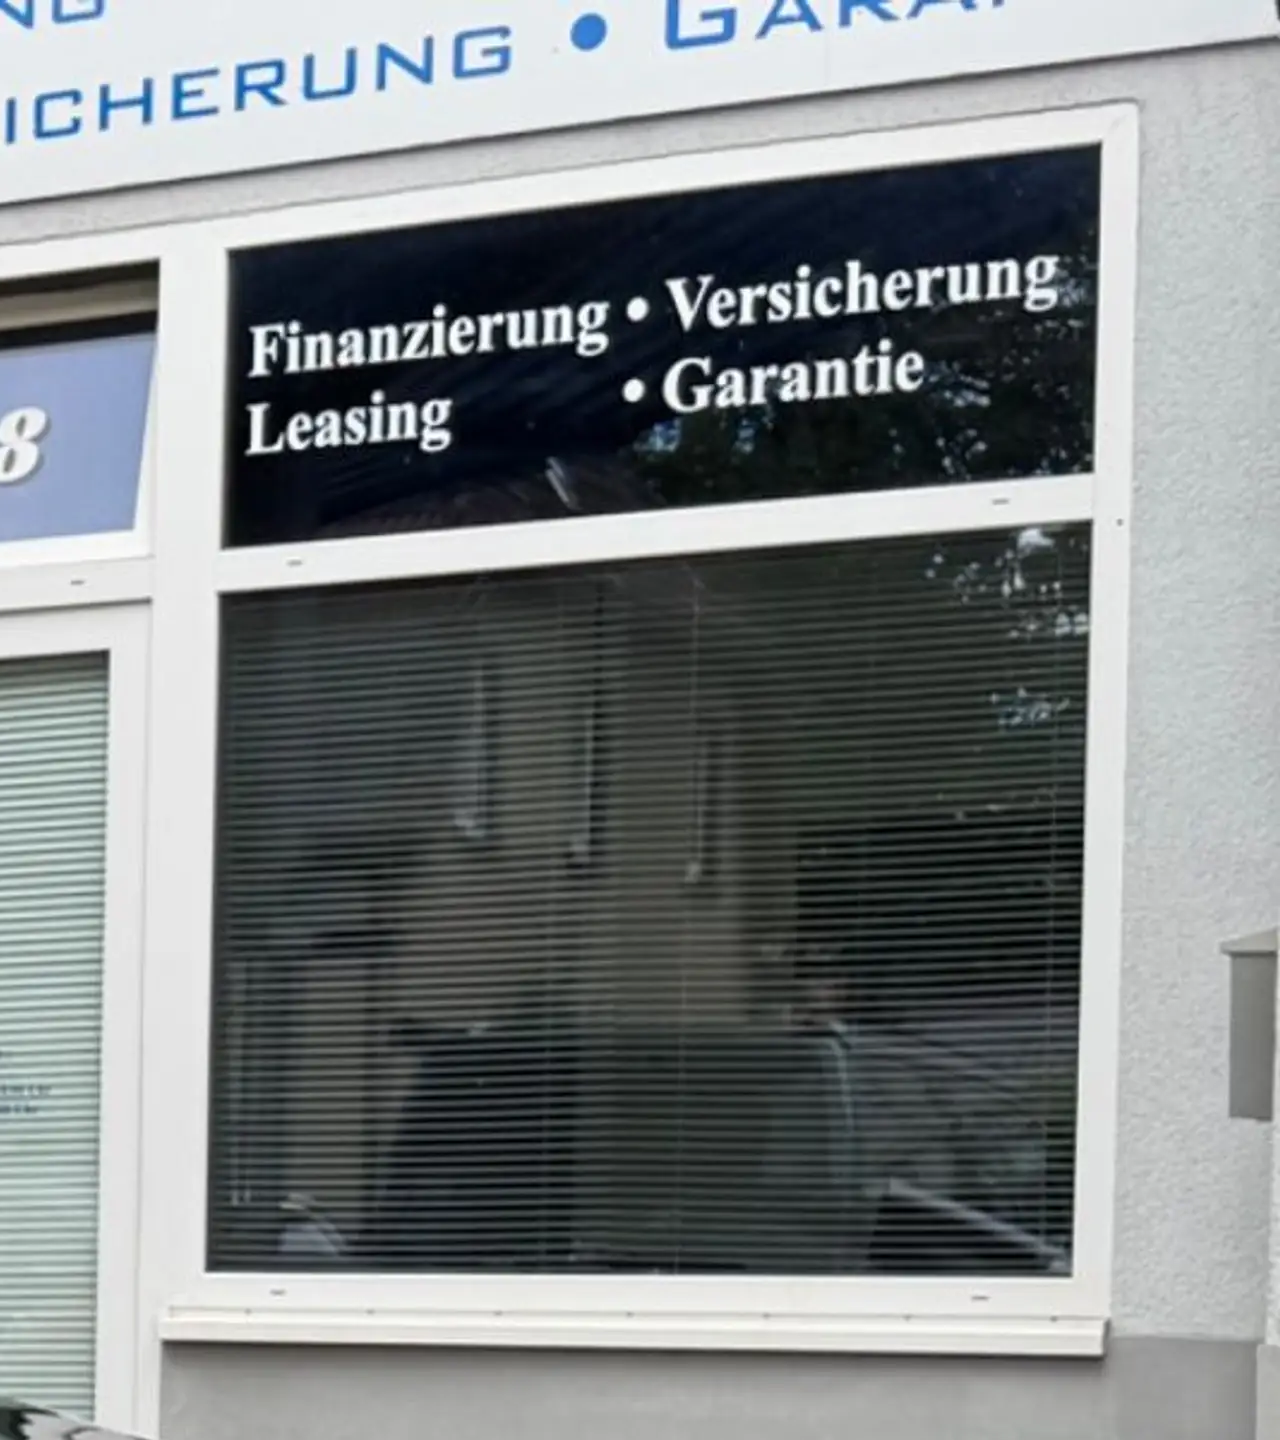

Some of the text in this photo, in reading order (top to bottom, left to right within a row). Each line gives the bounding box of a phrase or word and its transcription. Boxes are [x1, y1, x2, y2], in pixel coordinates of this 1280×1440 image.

[248, 254, 1061, 378] Finanzierung Versicherung
[244, 338, 926, 456] Leasing Garantie
